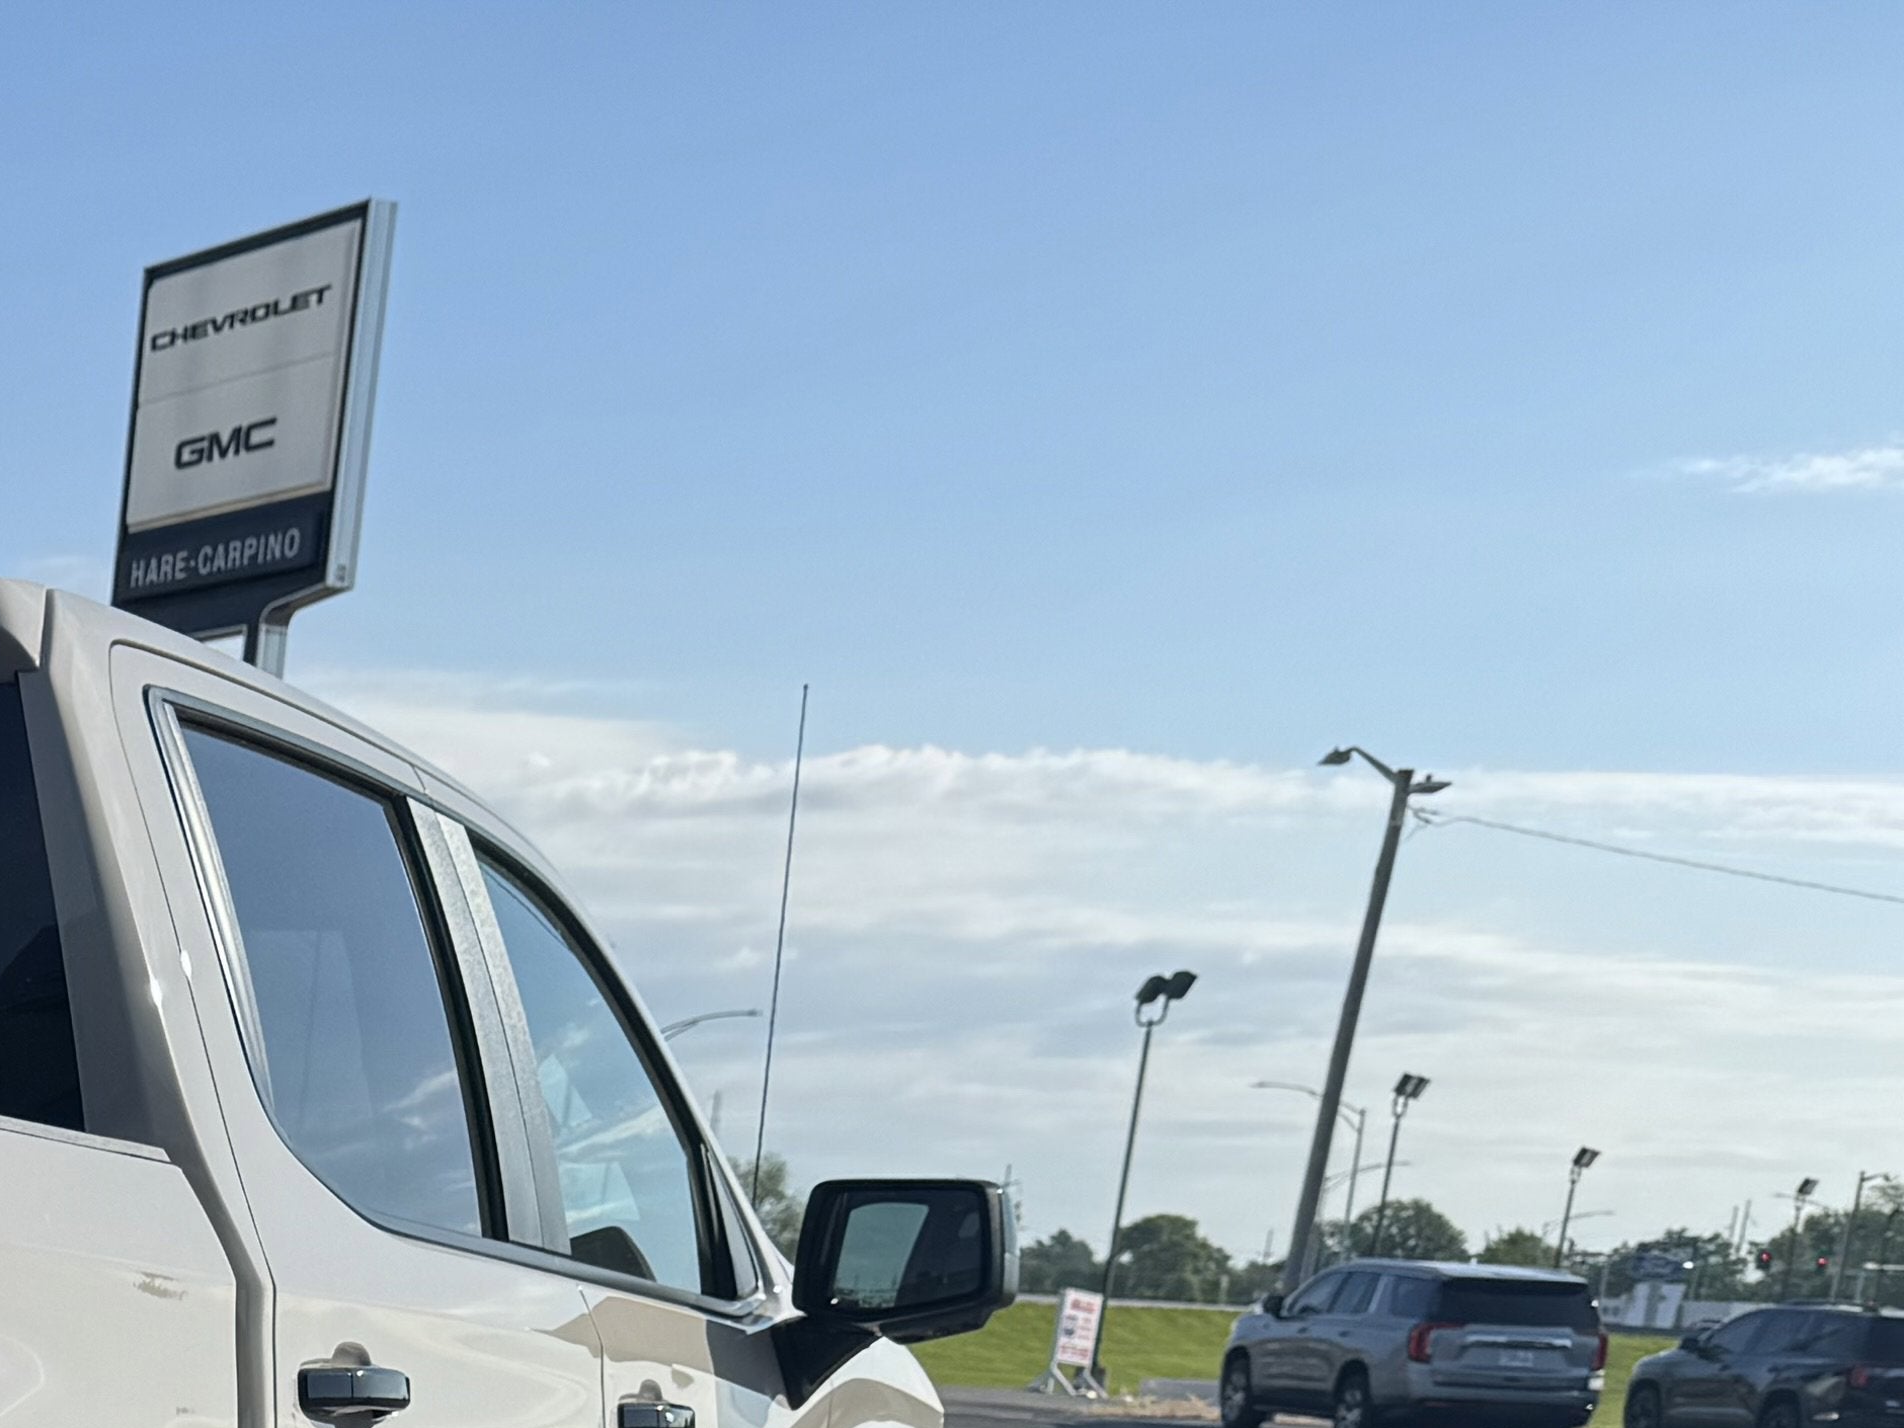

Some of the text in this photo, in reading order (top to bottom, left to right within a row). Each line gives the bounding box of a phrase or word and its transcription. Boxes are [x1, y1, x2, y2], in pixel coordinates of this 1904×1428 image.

[150, 284, 332, 352] CHEVROLET
[174, 417, 278, 470] GMC
[130, 527, 301, 588] HARE-CARPINO
